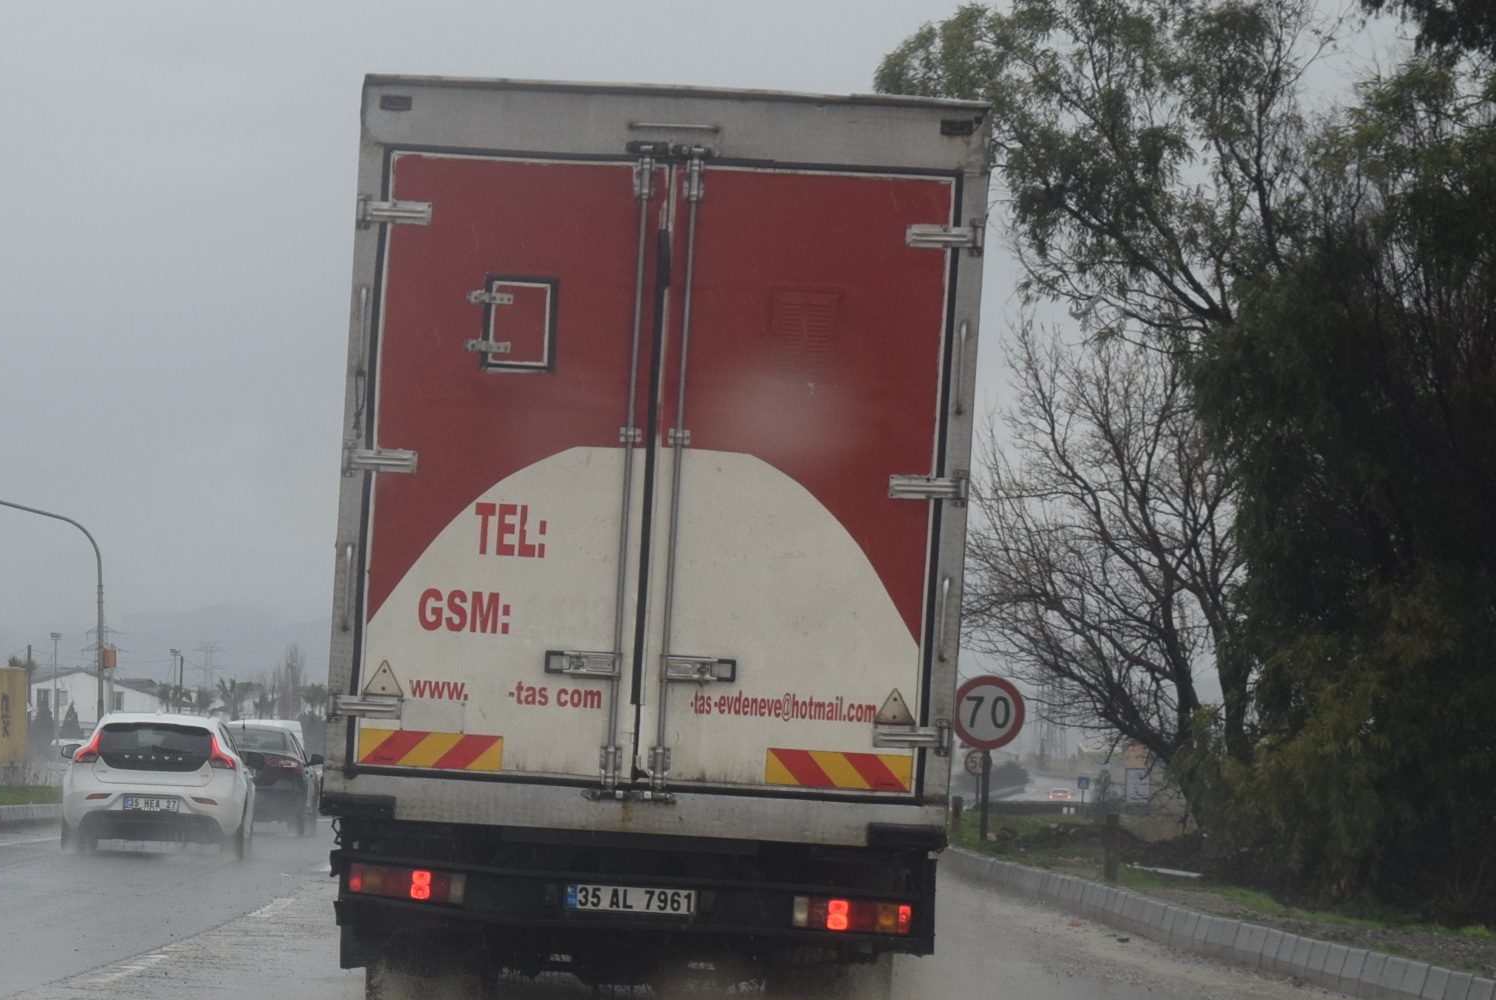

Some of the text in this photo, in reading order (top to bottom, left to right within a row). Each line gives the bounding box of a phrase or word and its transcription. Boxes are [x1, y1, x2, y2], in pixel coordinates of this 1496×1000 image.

[475, 502, 547, 558] TEL:
[418, 588, 511, 635] GSM:
[409, 679, 602, 709] www. -tas com
[966, 696, 1010, 729] 70
[128, 798, 139, 808] 35
[166, 800, 177, 809] 27
[578, 887, 601, 908] 35
[609, 888, 633, 910] AL
[644, 890, 693, 913] 7961
